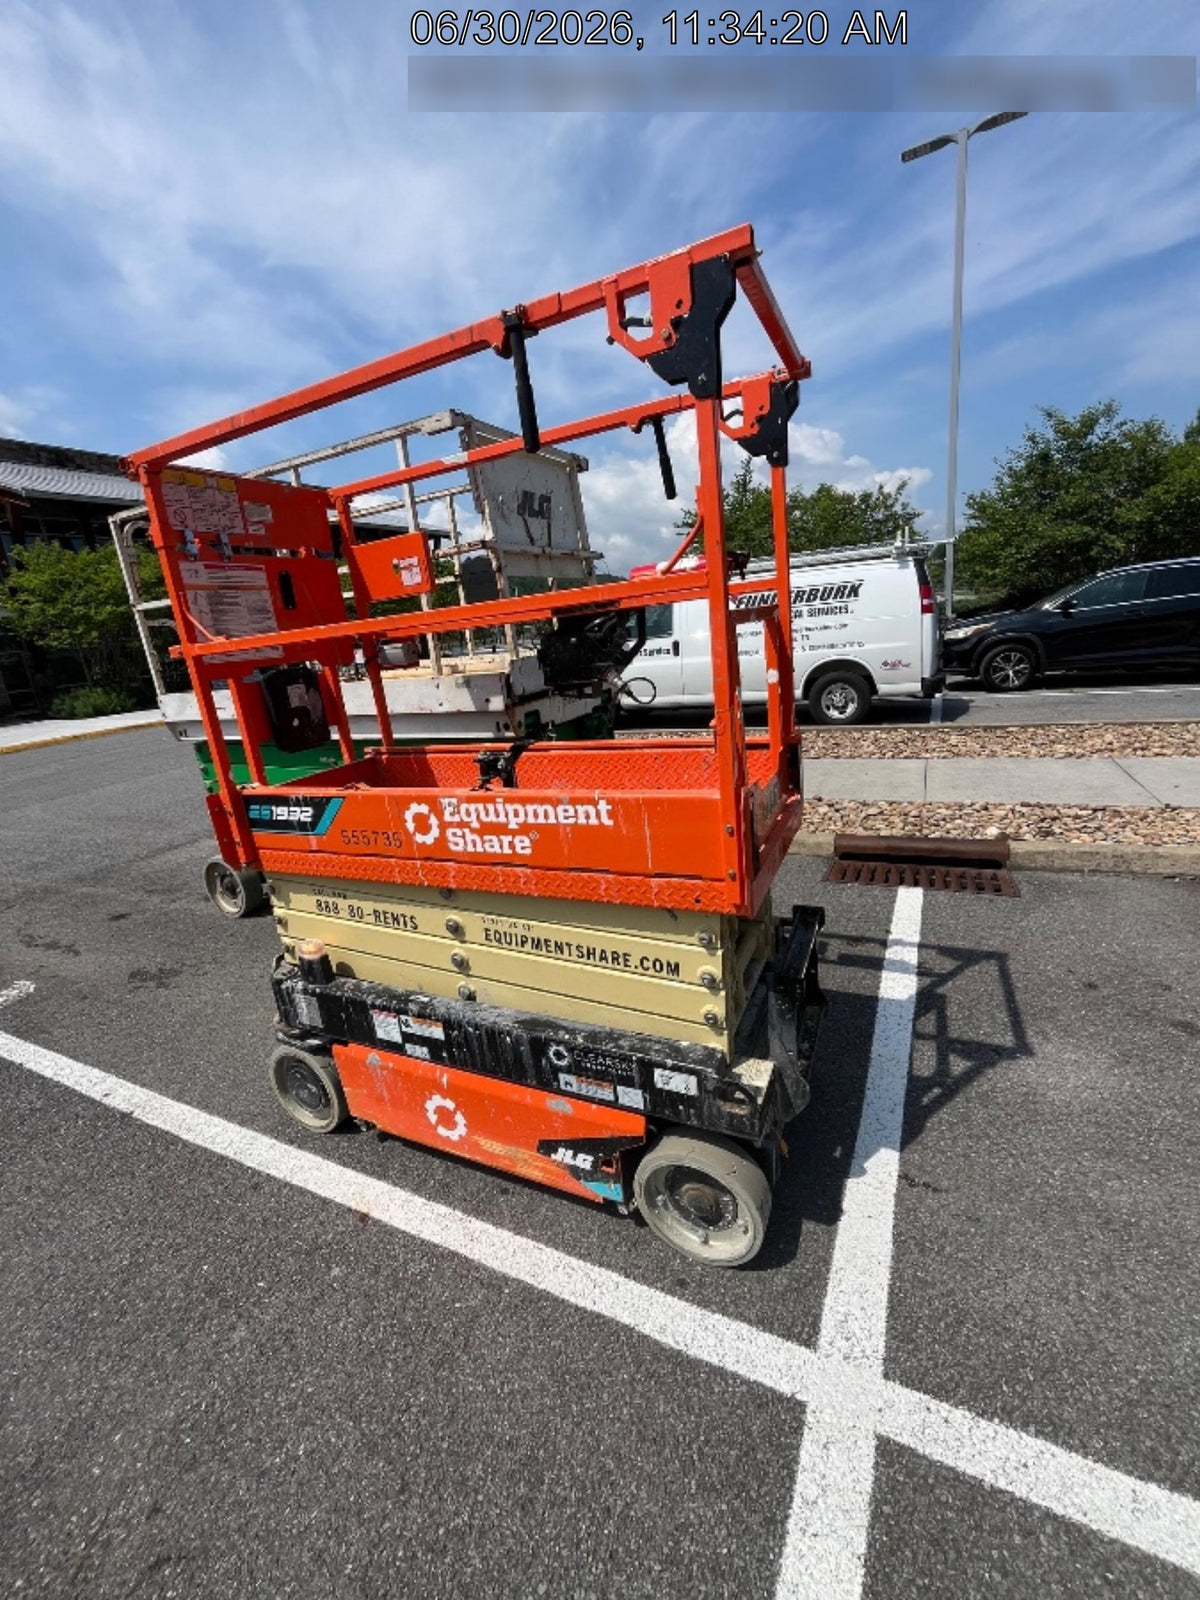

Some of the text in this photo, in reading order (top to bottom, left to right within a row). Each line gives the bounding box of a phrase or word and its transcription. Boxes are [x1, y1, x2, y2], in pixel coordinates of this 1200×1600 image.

[734, 583, 863, 608] FUNRBURK
[440, 798, 614, 829] Equipment
[484, 927, 681, 977] EQUIPMENTSHARE.COM
[550, 1147, 595, 1170] JLG
